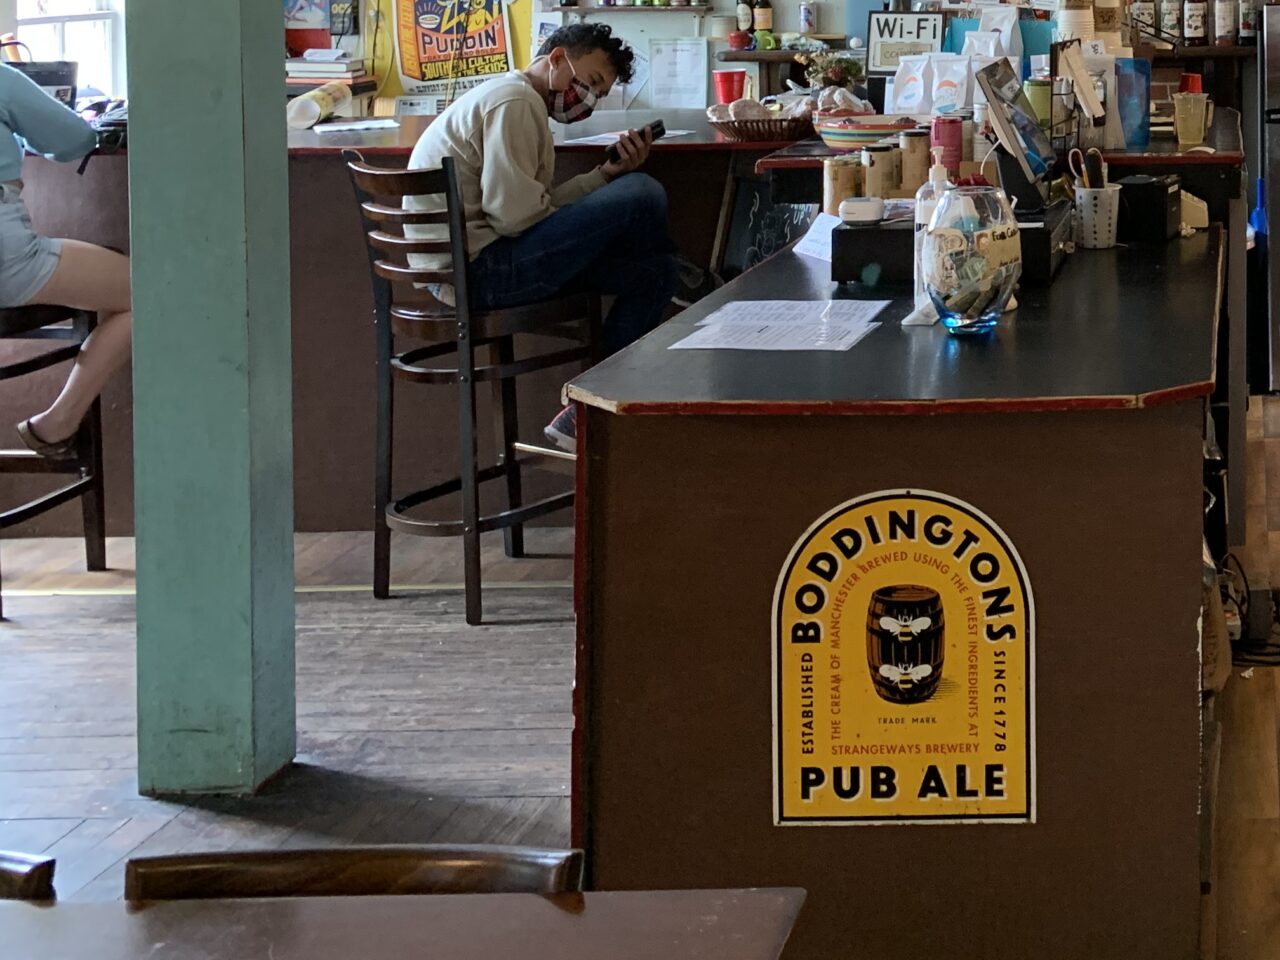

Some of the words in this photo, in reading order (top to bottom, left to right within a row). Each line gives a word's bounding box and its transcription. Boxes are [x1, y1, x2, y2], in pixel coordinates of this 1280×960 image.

[421, 21, 500, 55] PUDDIN'
[876, 17, 937, 39] Wi-Fi
[422, 58, 467, 80] SOUTHRN
[468, 53, 506, 68] CULTURE
[477, 60, 507, 75] SKIDS
[860, 551, 908, 575] BREWED
[913, 552, 950, 575] USING
[791, 510, 1016, 644] BODDINGTONS
[950, 572, 969, 594] THE
[831, 571, 861, 649] MANCHESTER
[963, 596, 978, 637] FINEST
[831, 655, 841, 673] OF
[993, 650, 1006, 704] SINCE
[968, 641, 979, 721] INGREDIENTS
[801, 652, 814, 755] ESTABLISHED
[830, 675, 841, 720] CREAM
[831, 724, 841, 741] THE
[878, 717, 906, 725] TRADE
[912, 716, 937, 724] MARK
[968, 724, 979, 738] AT
[993, 709, 1006, 752] 1778
[831, 744, 922, 756] STRANGEWAYS
[925, 743, 980, 755] BREWERY
[800, 765, 898, 801] PUB
[917, 764, 1005, 800] ALE
